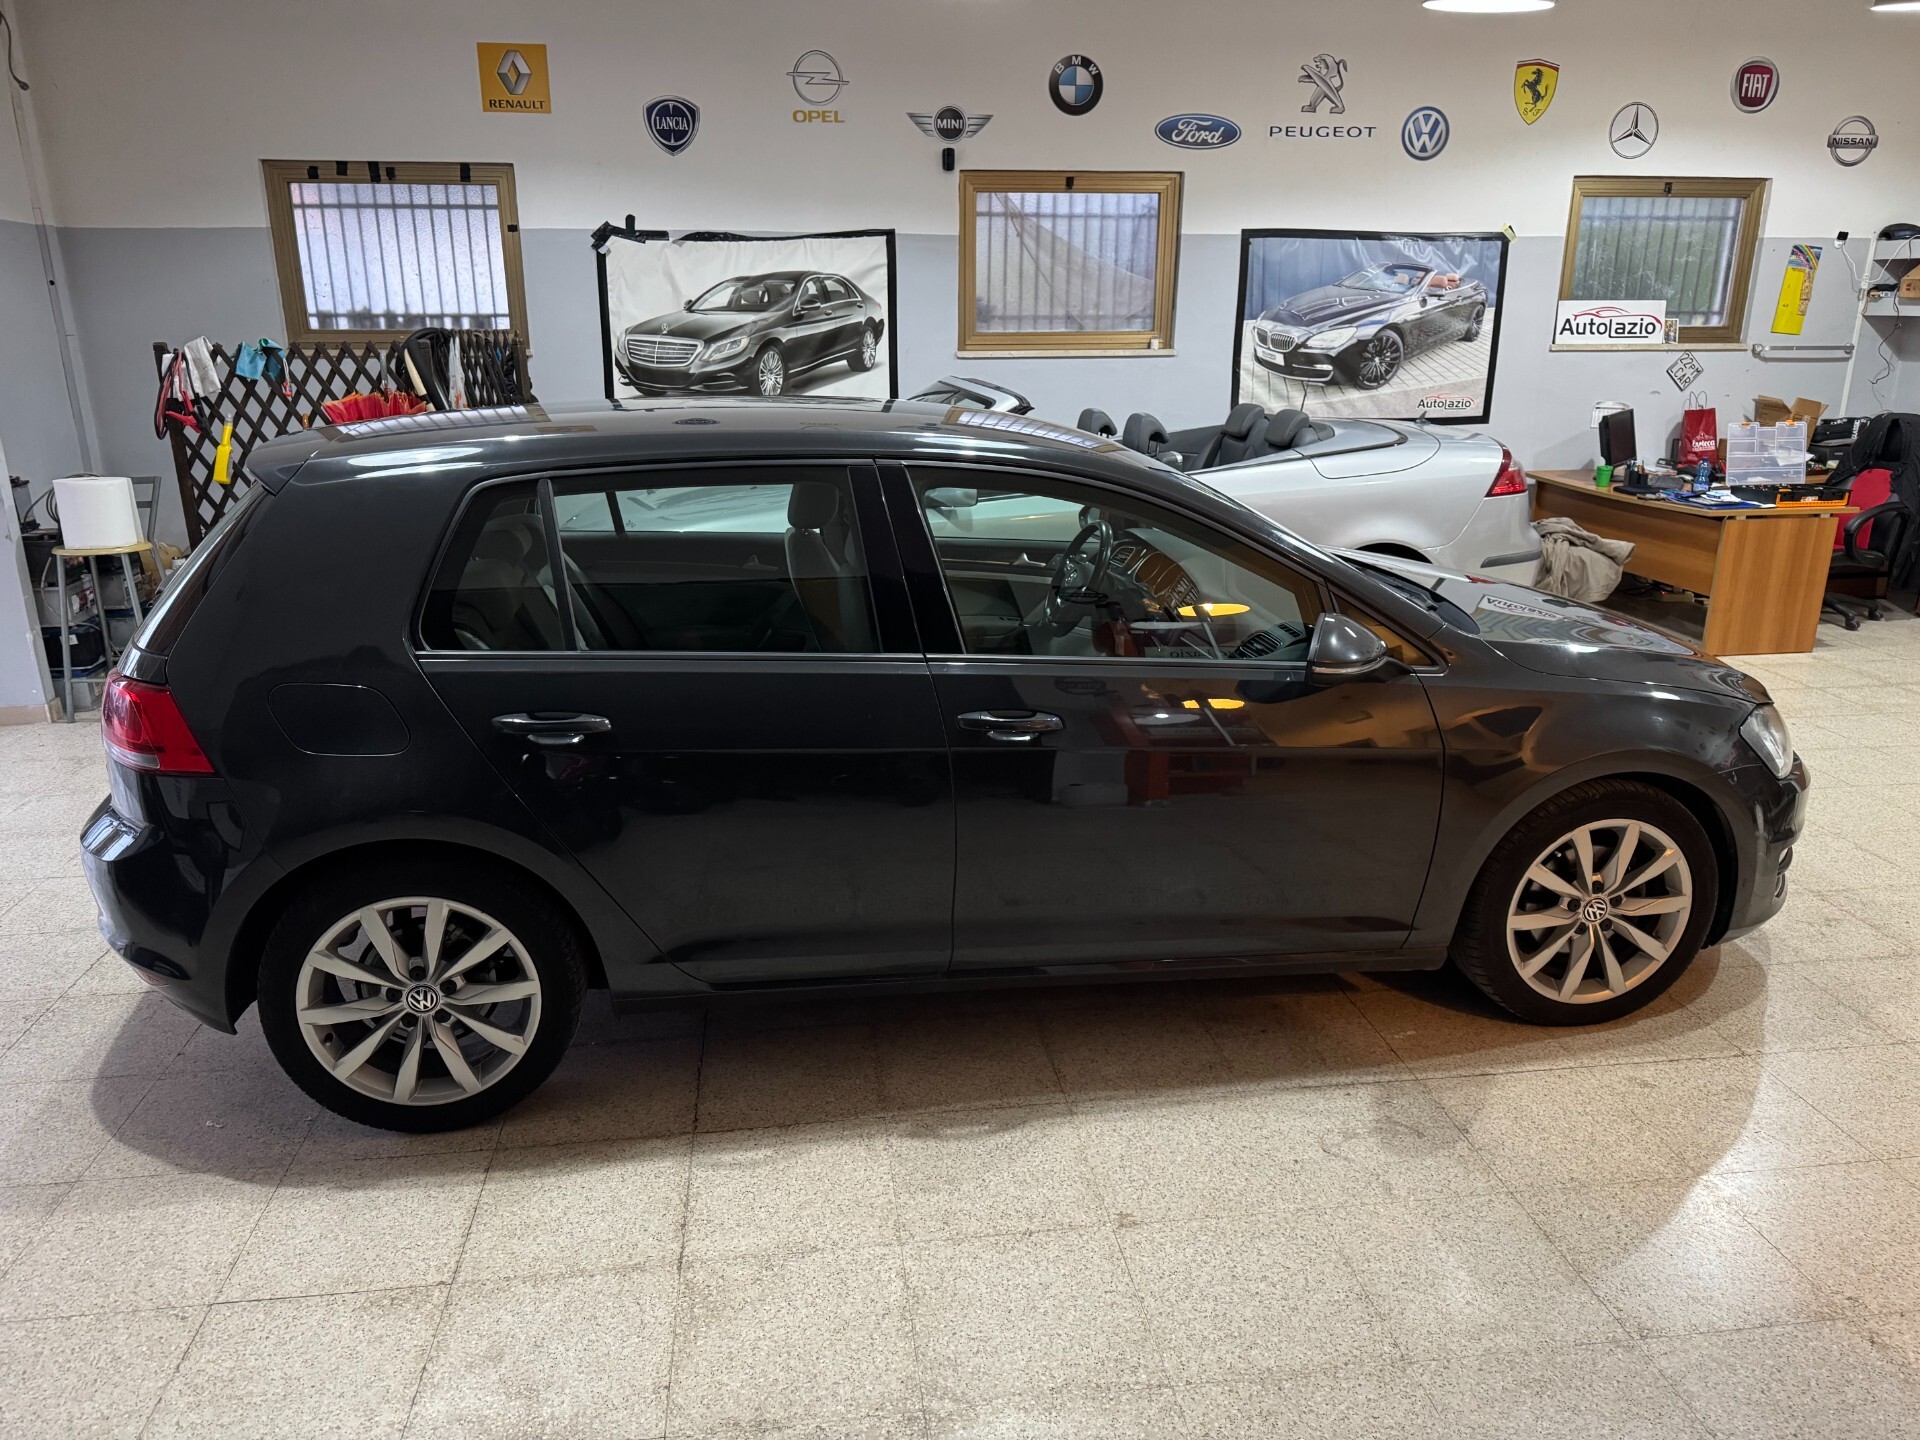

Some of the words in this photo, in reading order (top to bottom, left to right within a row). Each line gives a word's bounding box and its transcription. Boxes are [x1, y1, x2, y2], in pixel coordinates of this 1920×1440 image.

[1054, 55, 1099, 75] BMW
[1741, 73, 1770, 98] FIAT
[489, 99, 545, 110] RENAULT
[655, 116, 689, 130] LANCIA
[792, 109, 845, 123] OPEL
[937, 118, 963, 130] MINI
[1171, 118, 1225, 143] Ford
[1269, 126, 1377, 138] PEUGEOT
[1832, 137, 1873, 146] NISSAN
